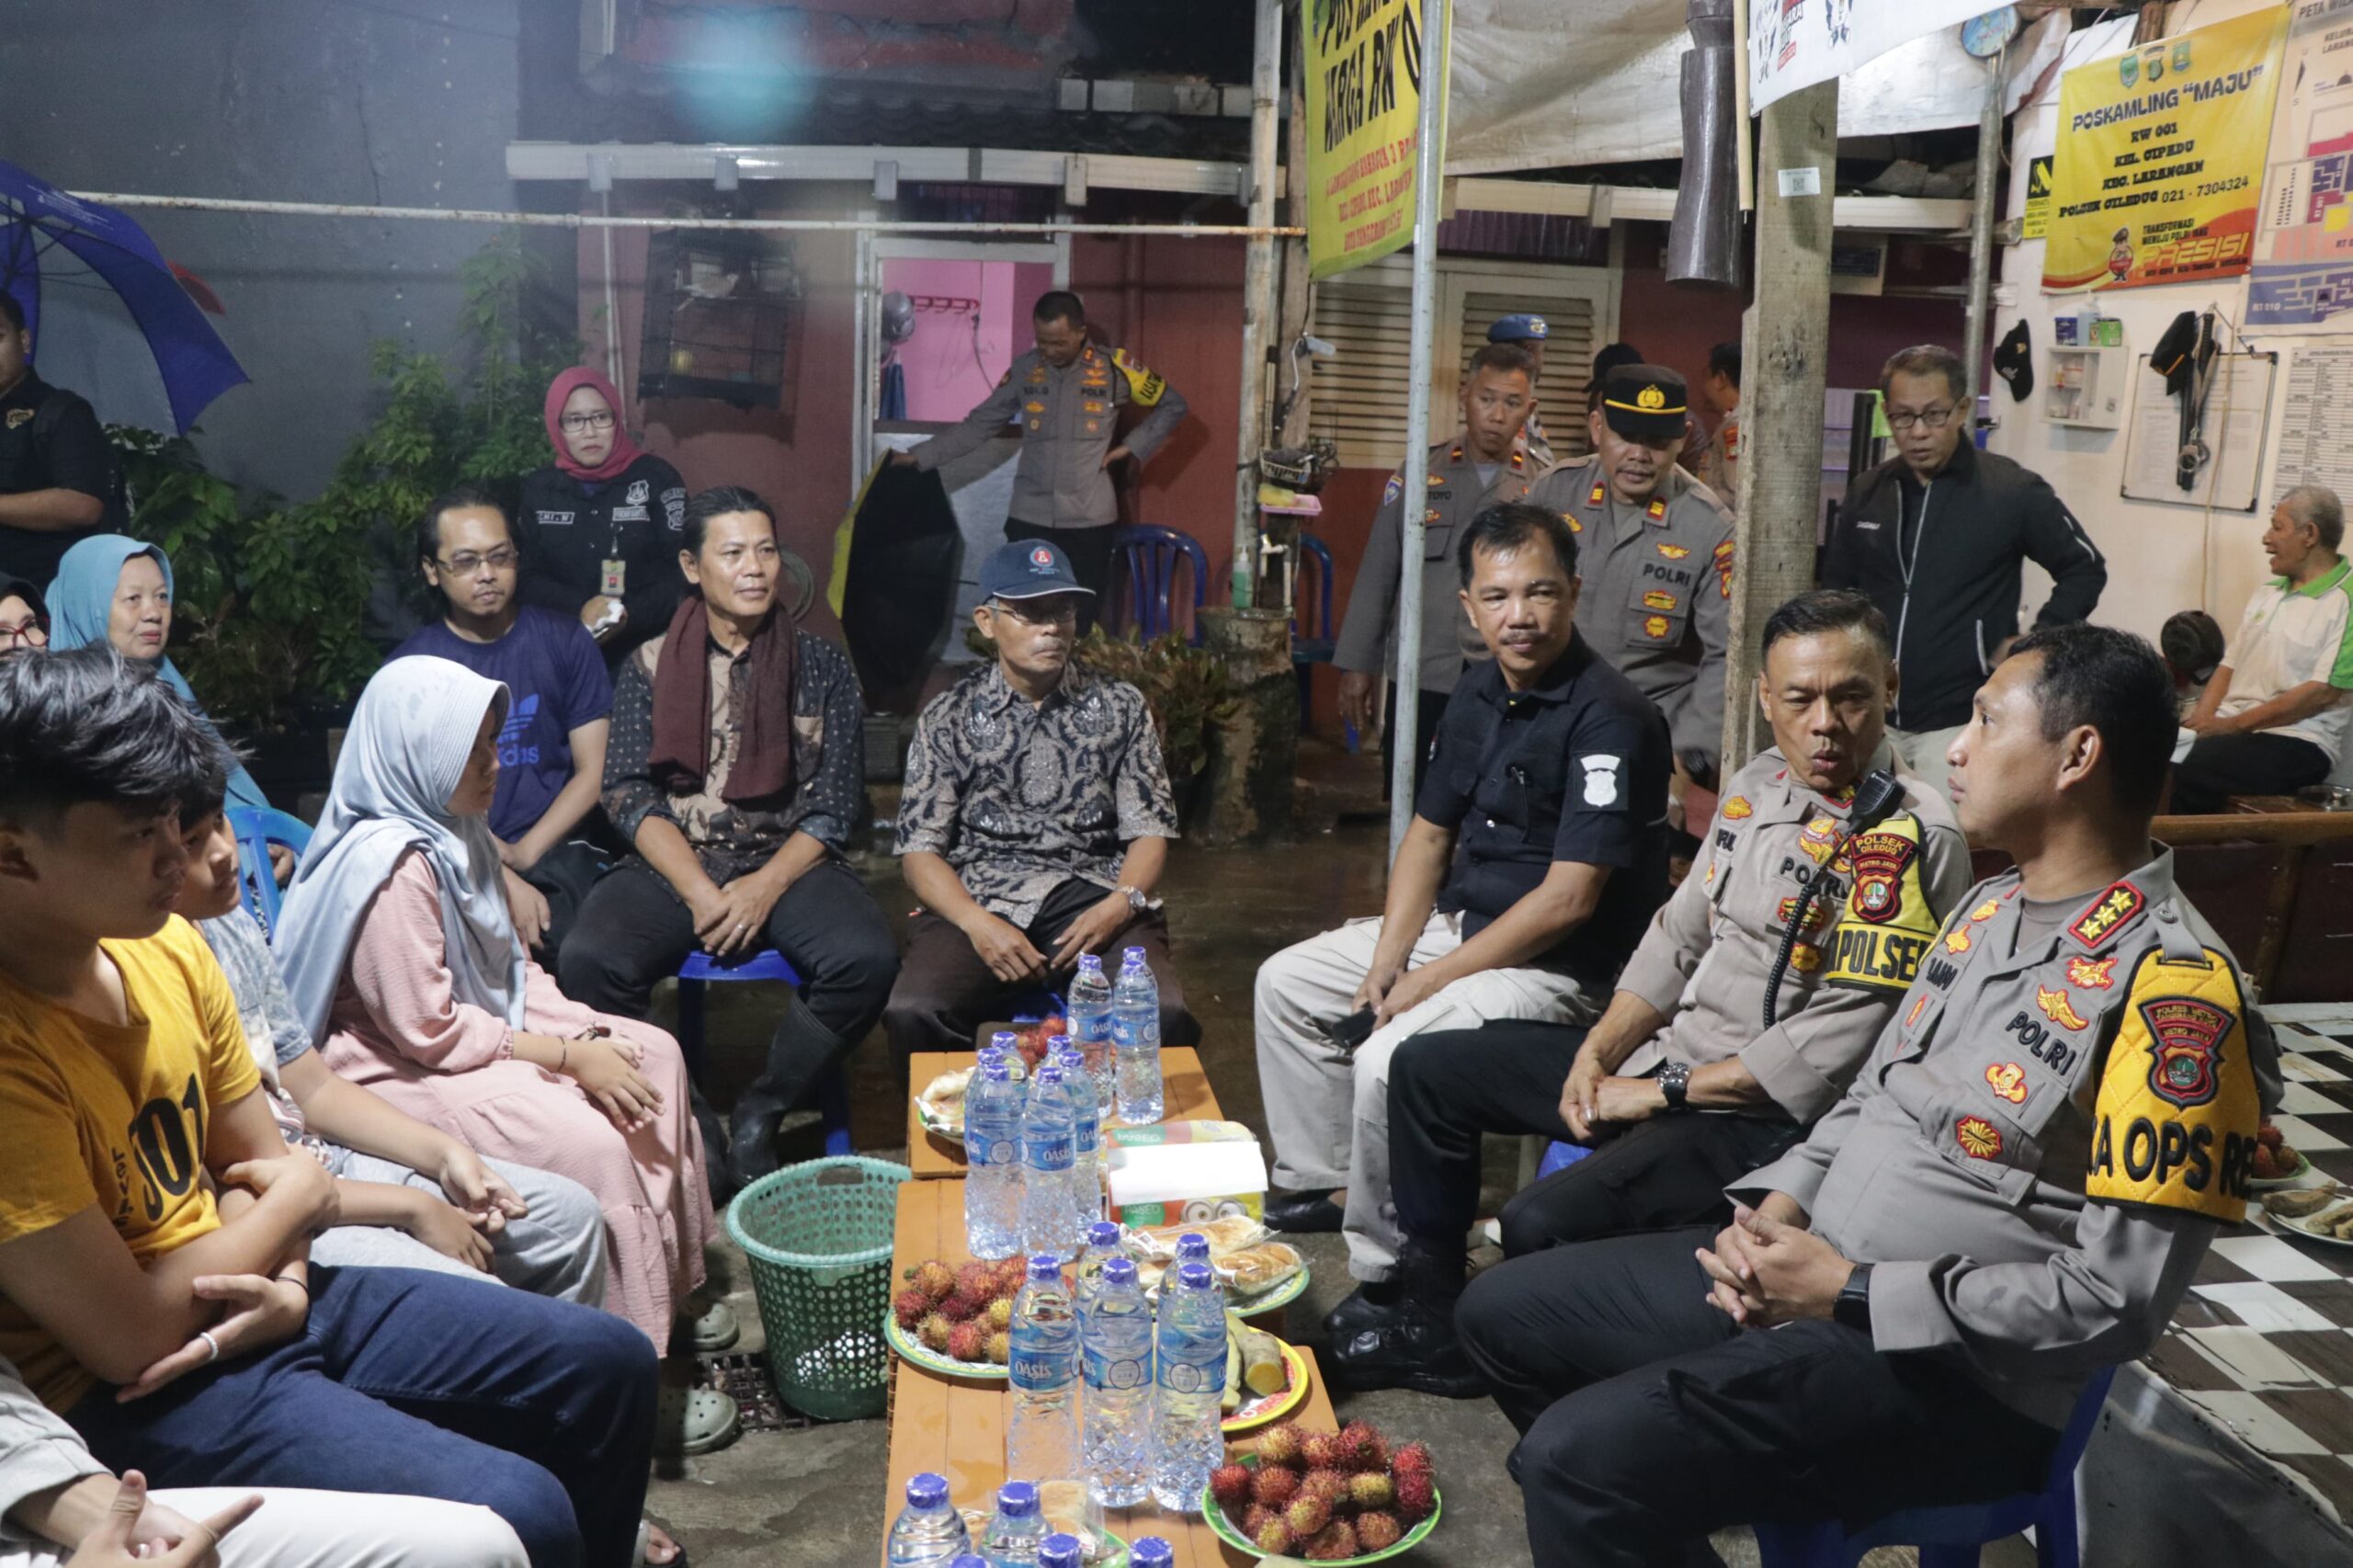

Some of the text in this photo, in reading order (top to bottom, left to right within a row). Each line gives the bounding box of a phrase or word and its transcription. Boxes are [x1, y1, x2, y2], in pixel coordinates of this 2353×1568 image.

[2073, 89, 2178, 131] POSKAMLING
[2131, 122, 2177, 142] RW 001
[2162, 188, 2185, 203] 021
[2197, 175, 2250, 197] 7304324
[2143, 218, 2195, 234] TRANSFORMASI
[2142, 232, 2251, 273] PRESISI
[1081, 388, 1108, 398] POLRI
[1643, 562, 1690, 586] POLRI
[1856, 835, 1906, 852] POLSEK
[1779, 856, 1847, 900] PORI
[2005, 1010, 2076, 1076] POLRI
[2087, 1114, 2257, 1200] A OPS RE
[1015, 1359, 1052, 1380] OASIS
